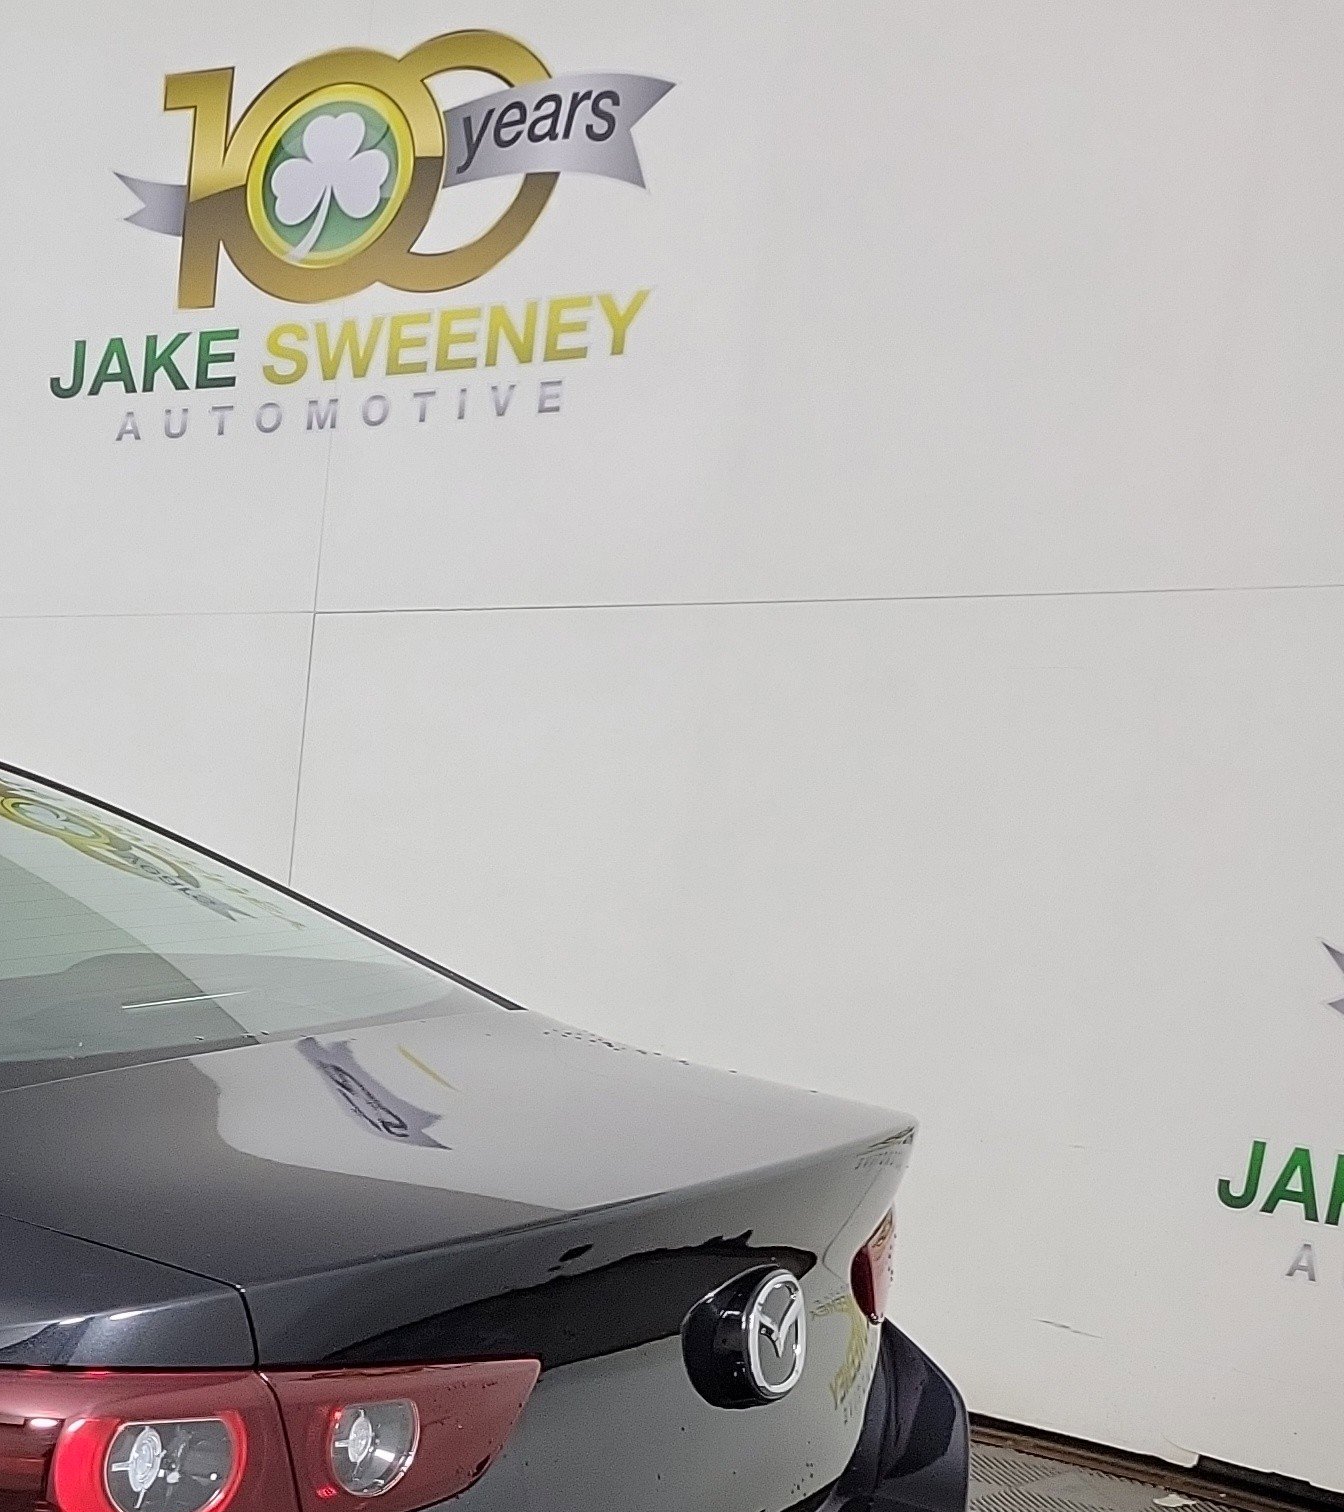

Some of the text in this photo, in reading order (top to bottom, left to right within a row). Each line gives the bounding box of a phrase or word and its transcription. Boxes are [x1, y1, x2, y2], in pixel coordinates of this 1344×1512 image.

[164, 29, 620, 309] 100 years
[49, 289, 652, 399] JAKE SWEENEY
[115, 379, 564, 442] AUTOMOTIVE
